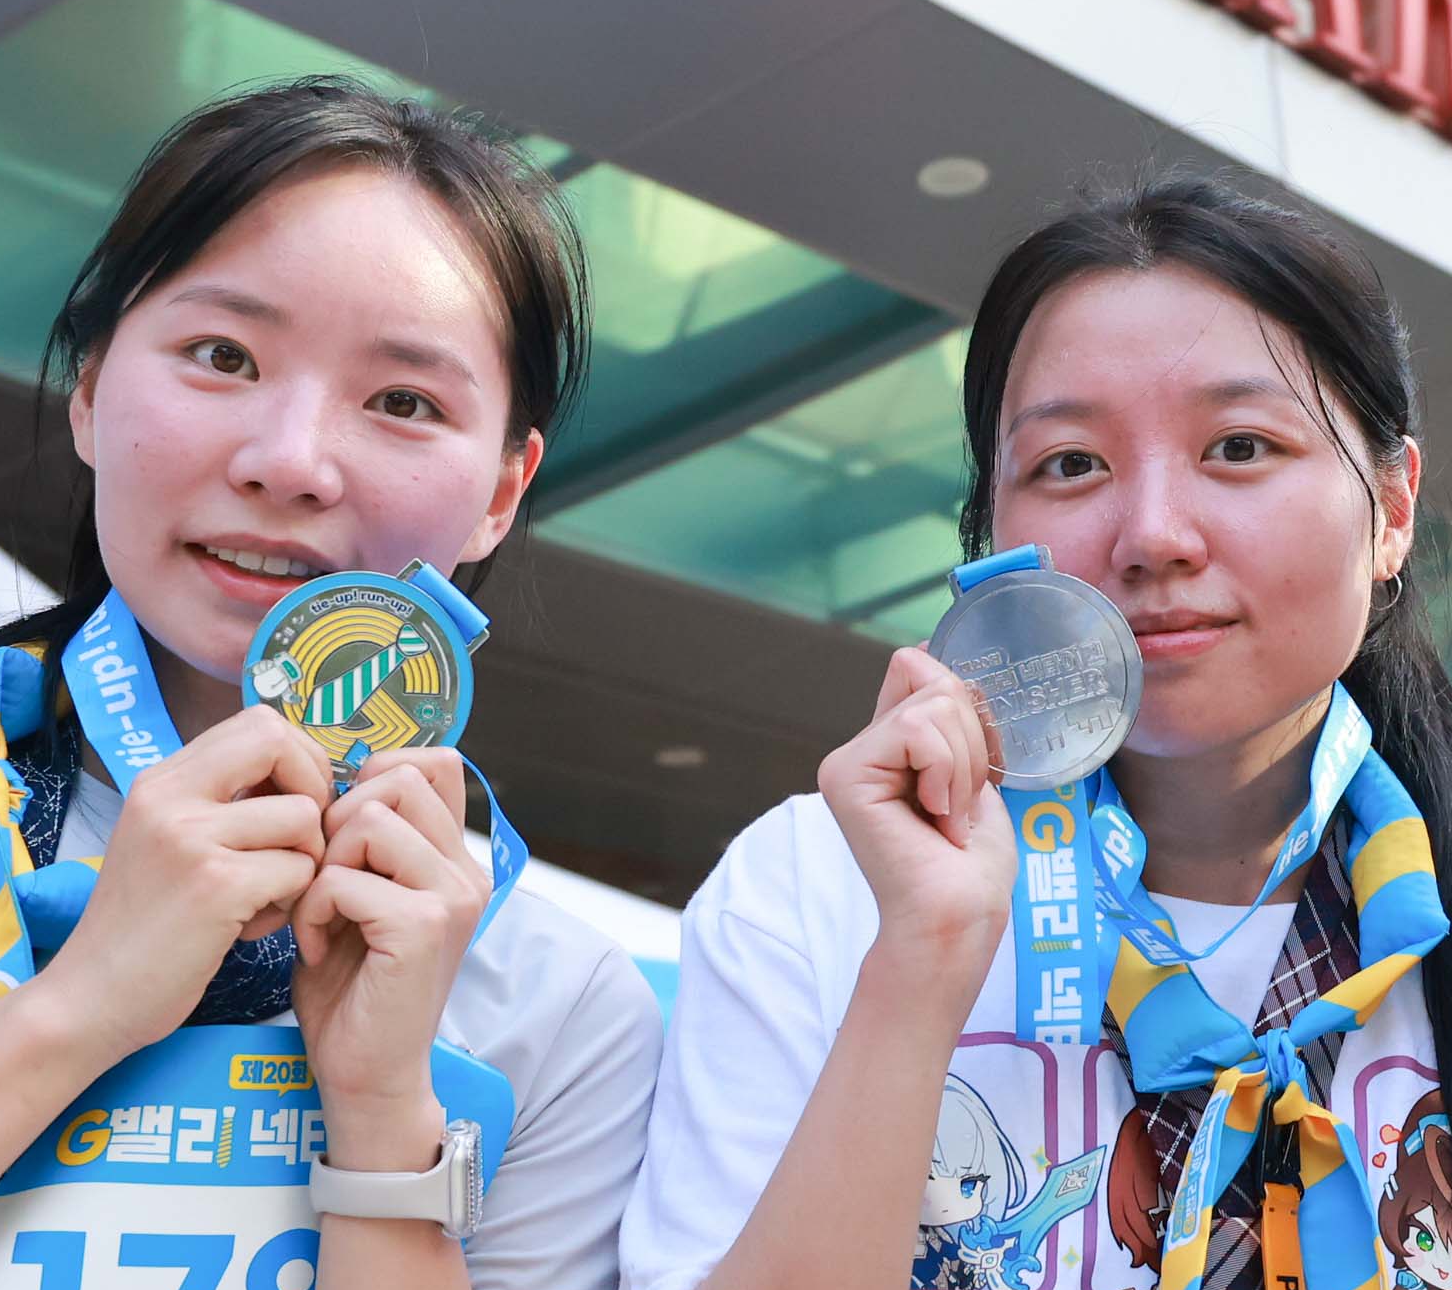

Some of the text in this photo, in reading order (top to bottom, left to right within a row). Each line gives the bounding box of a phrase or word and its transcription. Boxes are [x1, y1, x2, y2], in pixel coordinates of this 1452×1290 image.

[311, 591, 414, 617] tie-up! run-up!
[78, 641, 164, 767] tie-up!
[1022, 801, 1082, 953] G밸리
[56, 1105, 236, 1168] G밸리
